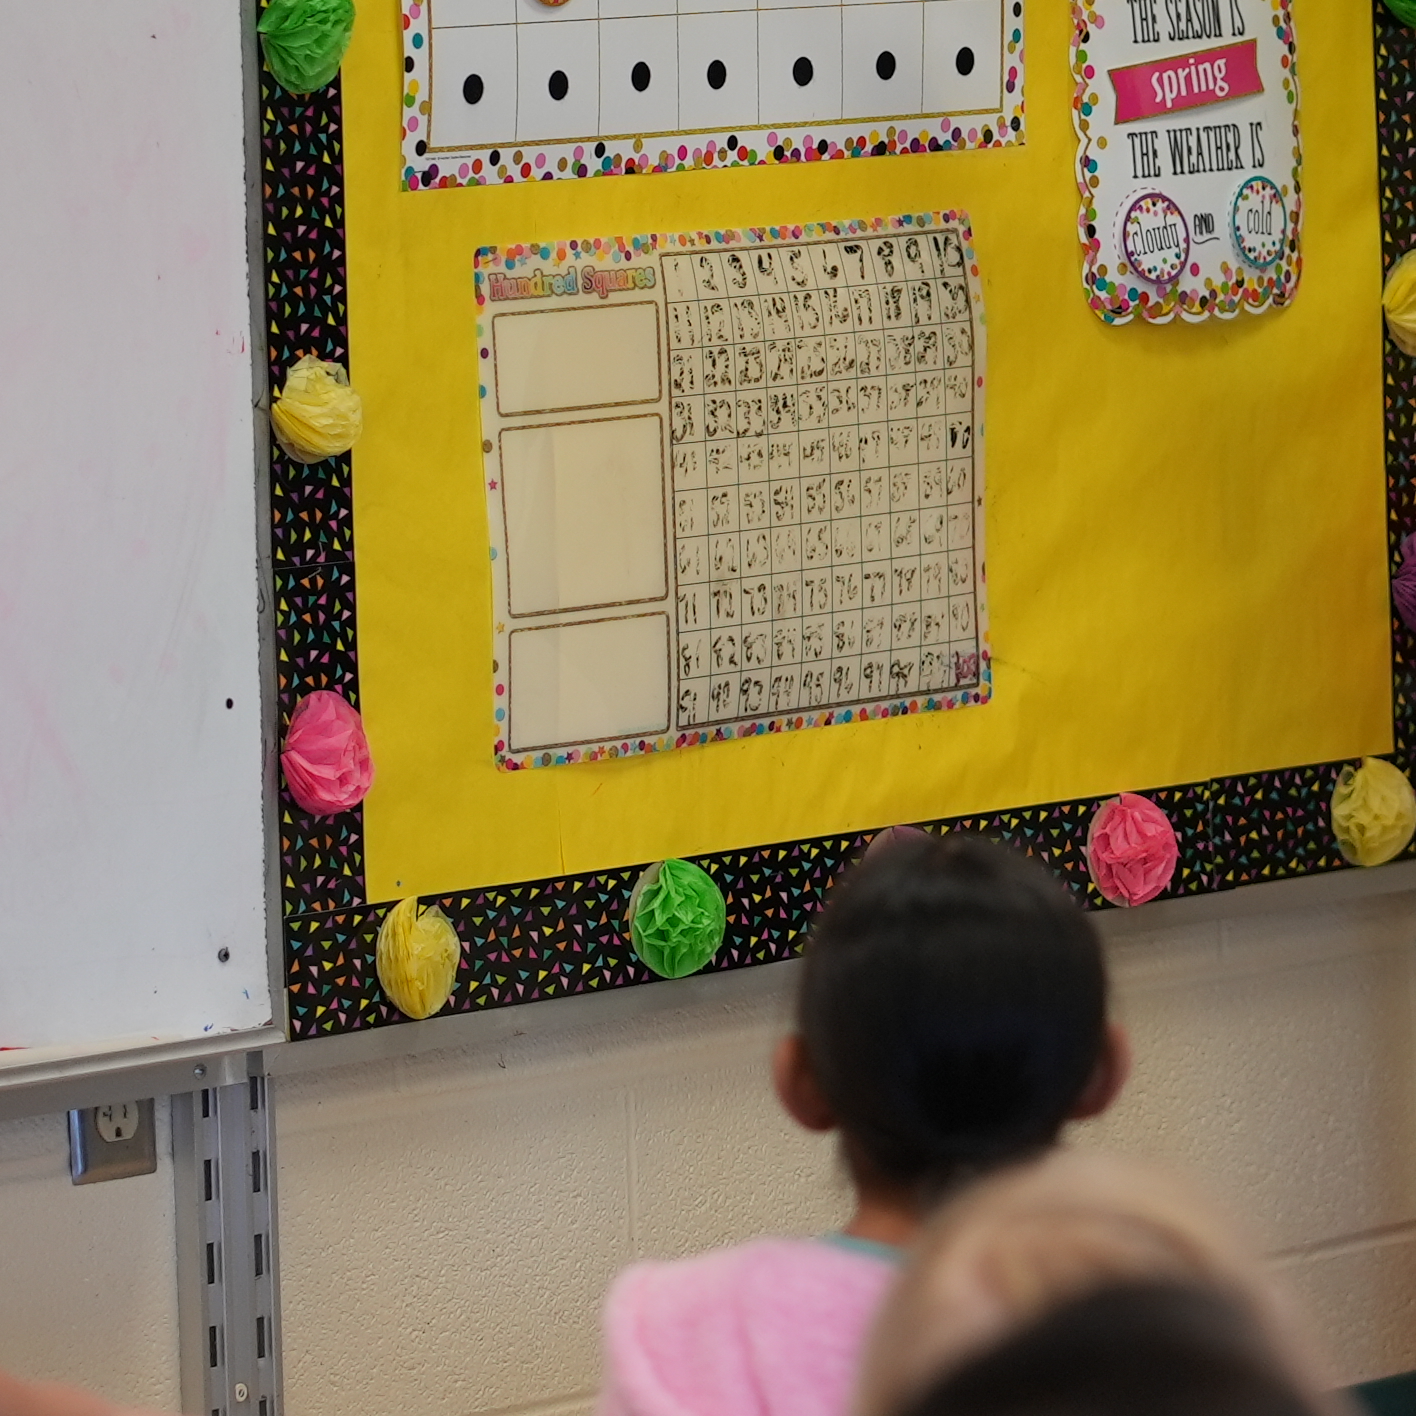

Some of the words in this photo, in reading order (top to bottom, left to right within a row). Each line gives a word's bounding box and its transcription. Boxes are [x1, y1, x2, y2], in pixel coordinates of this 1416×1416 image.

[1151, 57, 1228, 109] spring
[1127, 130, 1161, 179] THE
[1166, 123, 1245, 176] WEATHER
[1249, 122, 1265, 168] IS
[1132, 212, 1181, 257] cloudy
[1193, 213, 1215, 237] AND
[1246, 200, 1272, 236] cold
[489, 267, 577, 300] Hundred
[582, 266, 656, 298] Squares
[844, 244, 865, 280] 7
[877, 240, 895, 278] 8
[906, 237, 924, 277] 9
